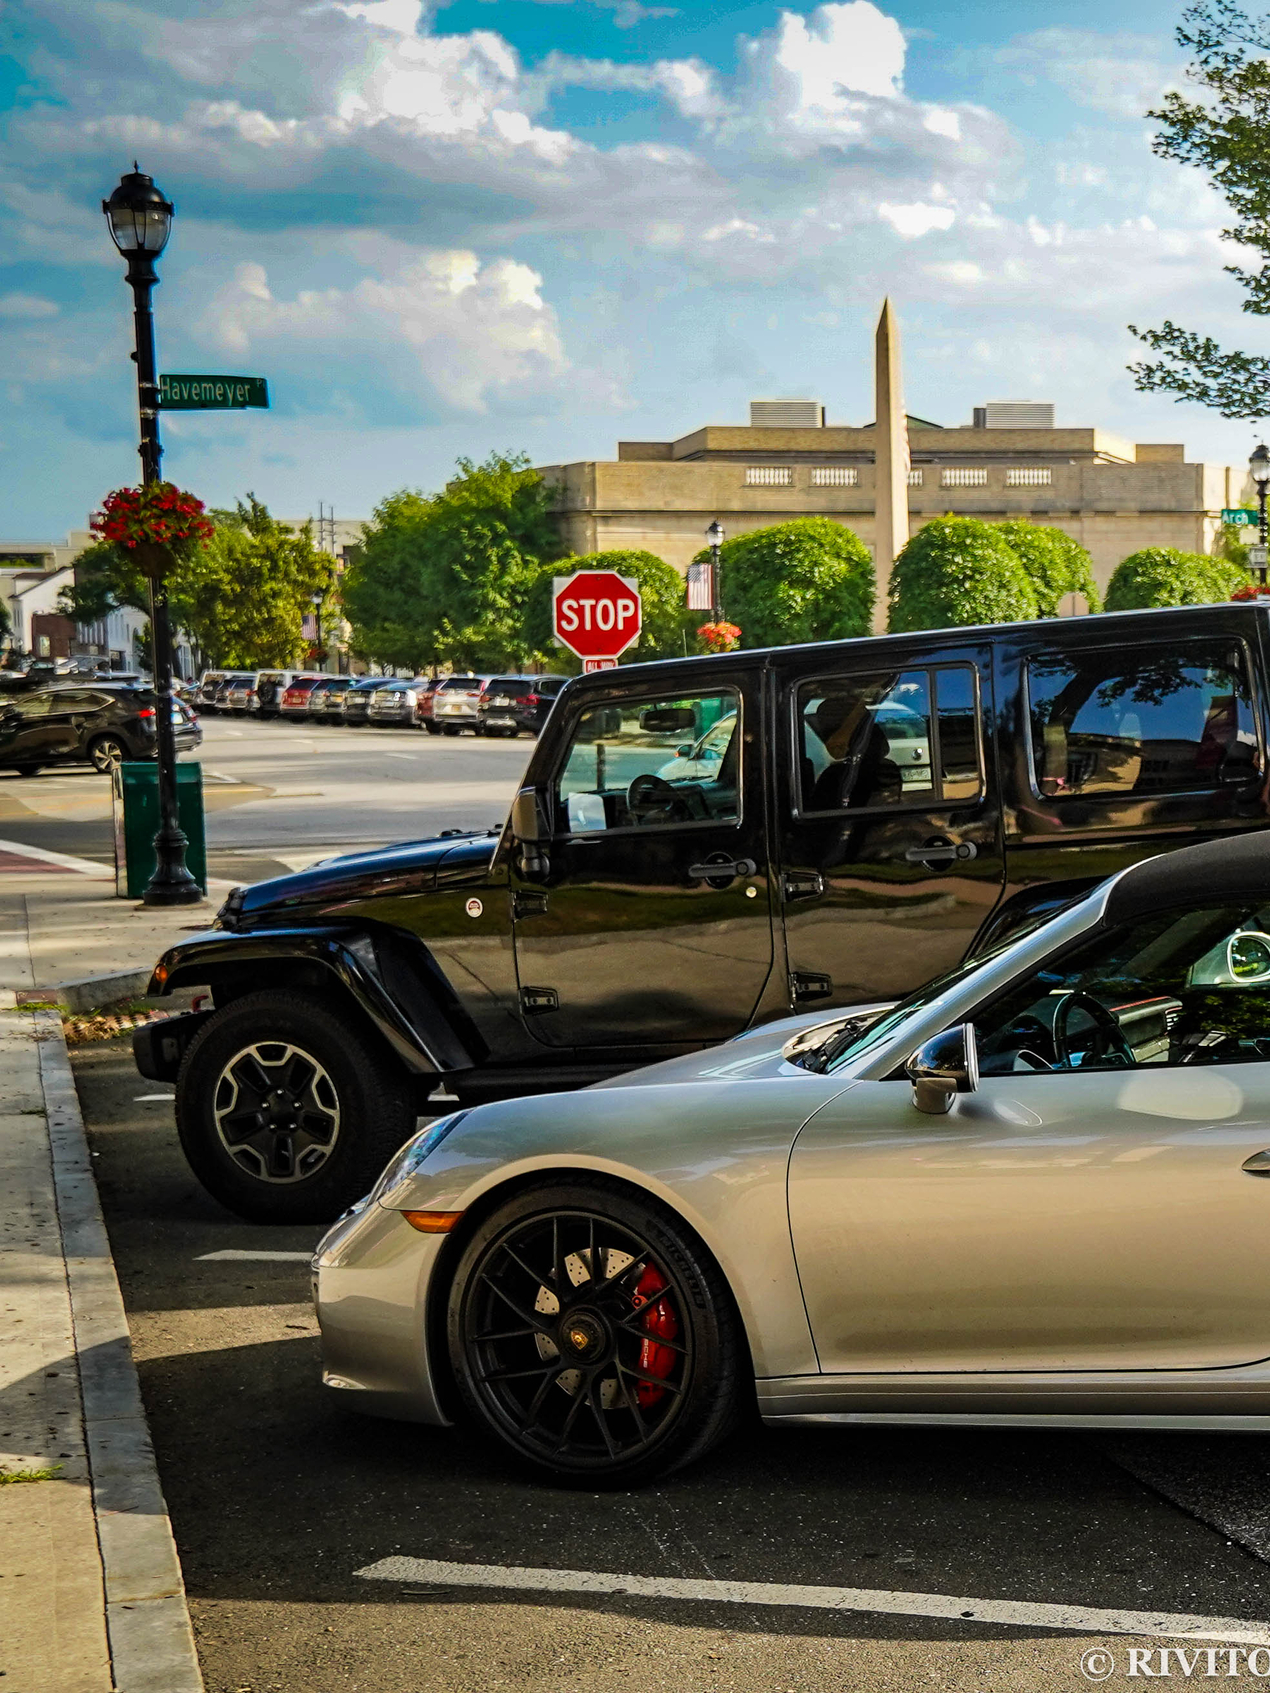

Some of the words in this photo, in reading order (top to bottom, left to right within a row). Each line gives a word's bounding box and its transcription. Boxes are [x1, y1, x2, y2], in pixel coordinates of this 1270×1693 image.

[161, 377, 250, 407] Havemeyer
[1222, 511, 1249, 525] Arch
[560, 598, 636, 632] STOP
